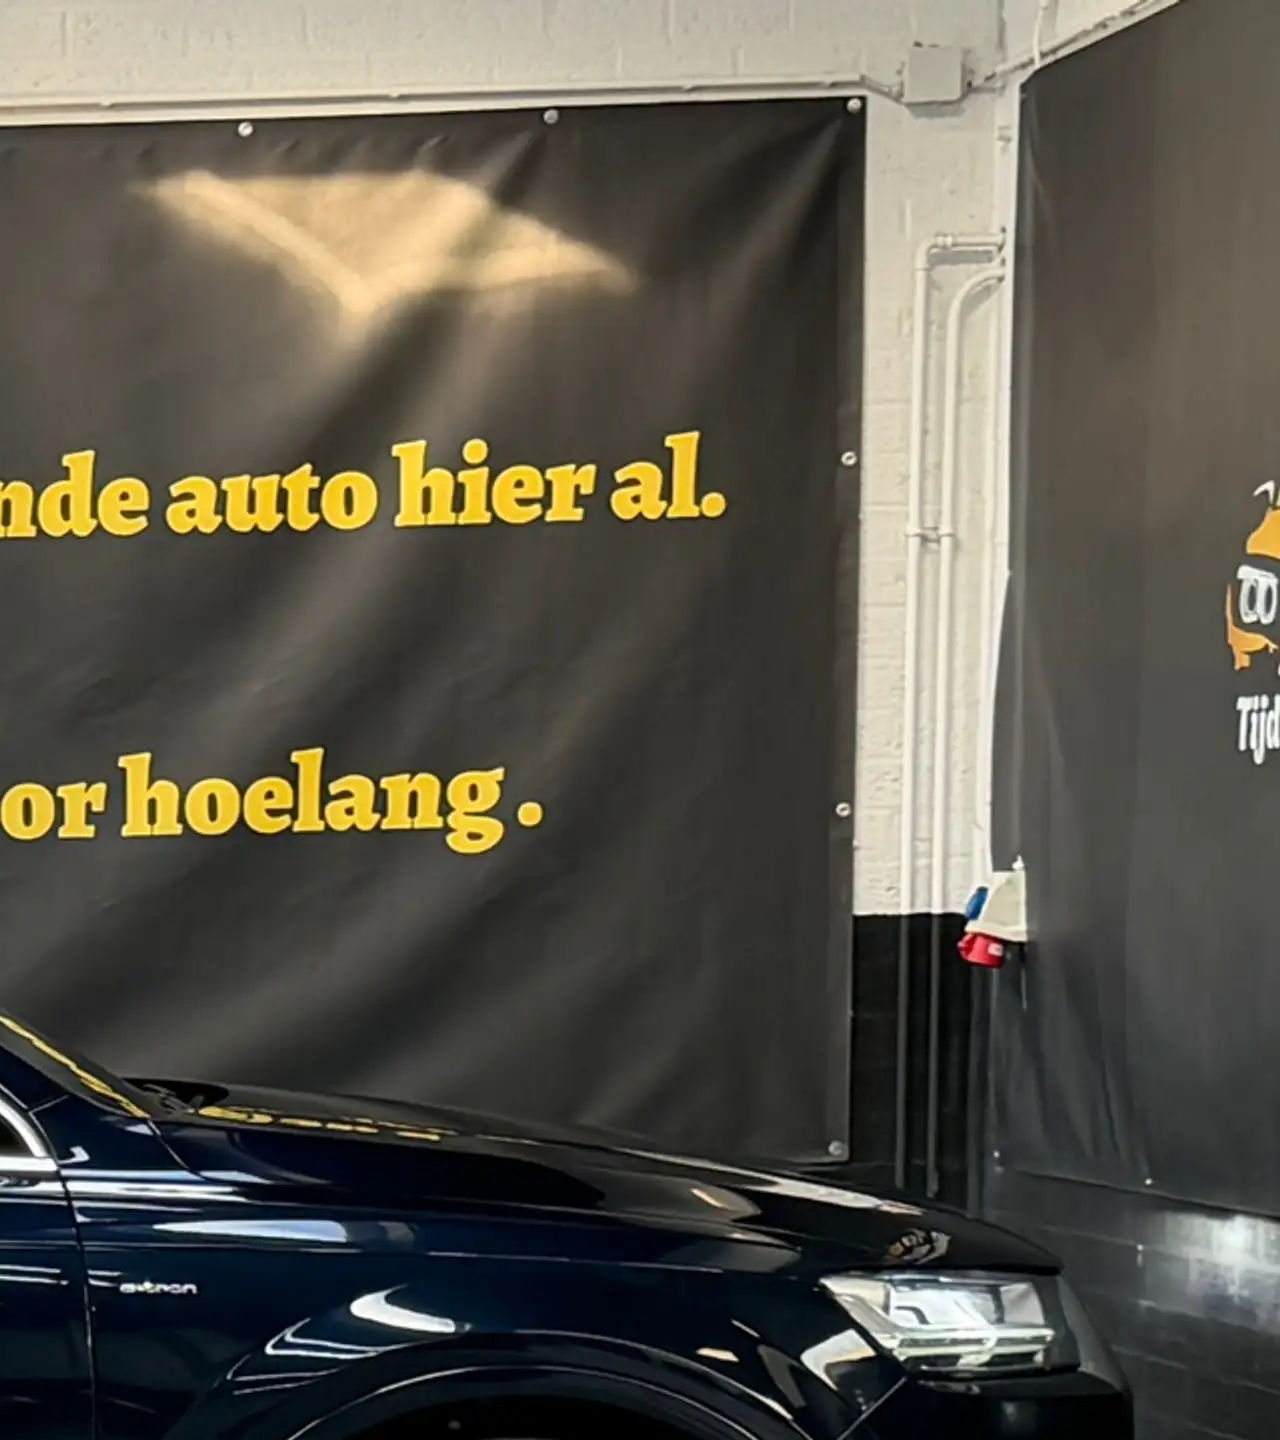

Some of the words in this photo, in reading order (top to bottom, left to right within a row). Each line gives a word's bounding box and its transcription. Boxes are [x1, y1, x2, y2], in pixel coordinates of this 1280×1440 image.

[164, 464, 379, 535] auto
[392, 438, 597, 528] hier
[609, 430, 727, 521] al.
[118, 746, 544, 854] hoelang.
